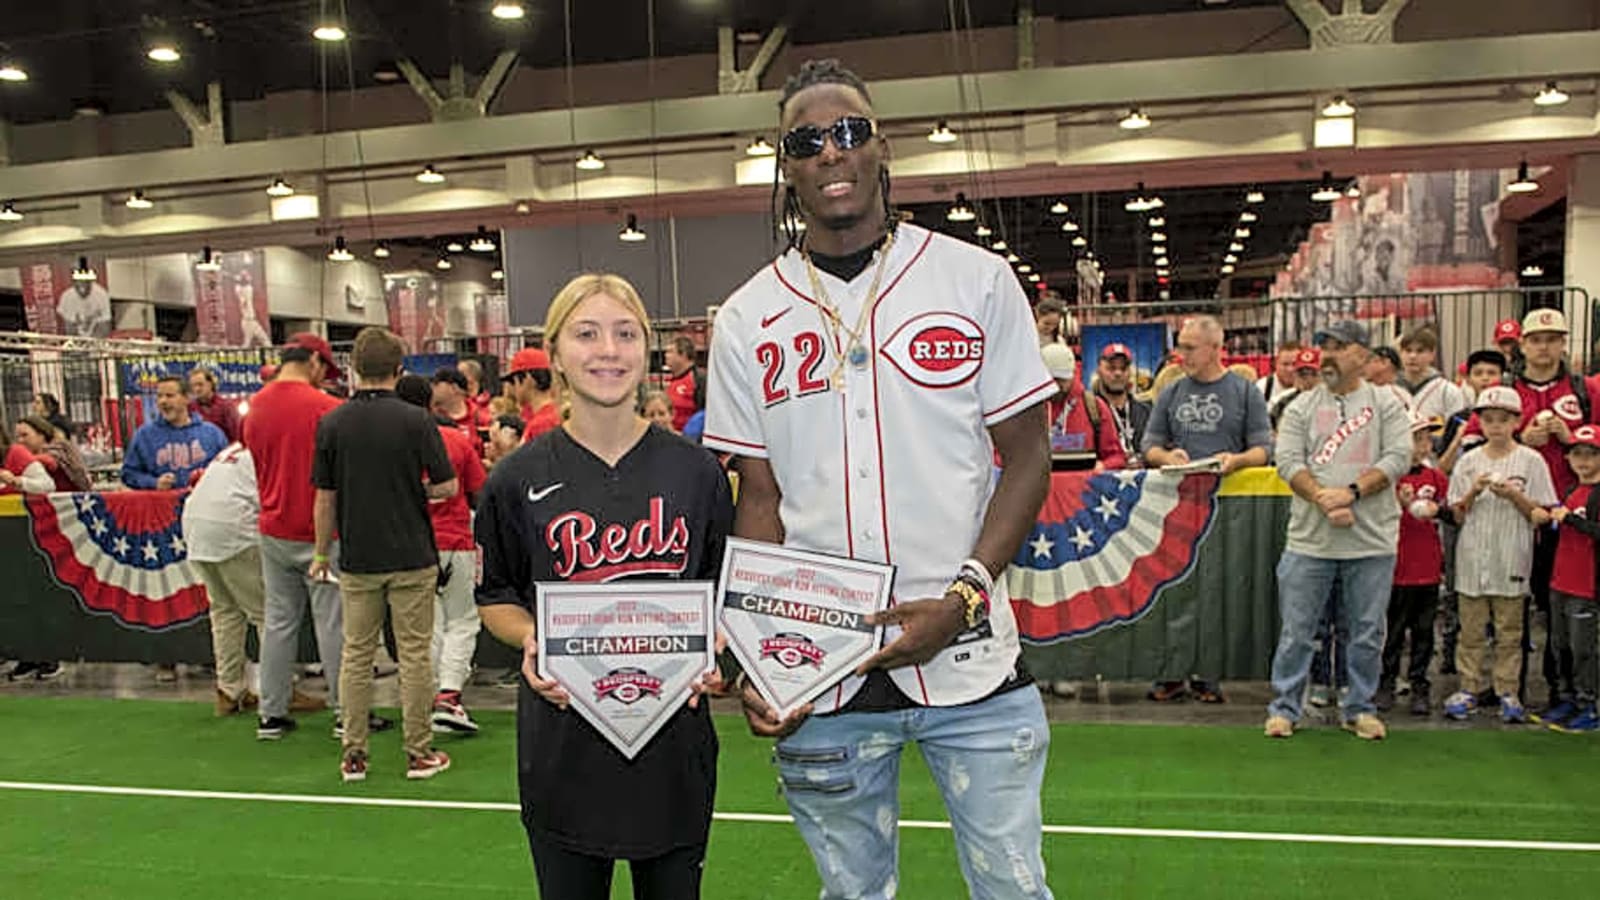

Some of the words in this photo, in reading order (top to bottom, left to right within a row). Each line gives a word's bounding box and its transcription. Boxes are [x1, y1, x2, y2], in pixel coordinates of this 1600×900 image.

[914, 340, 983, 359] REDS
[756, 331, 829, 407] 22
[545, 497, 689, 580] Reds
[741, 595, 859, 629] CHAMPION
[565, 636, 689, 654] CHAMPION
